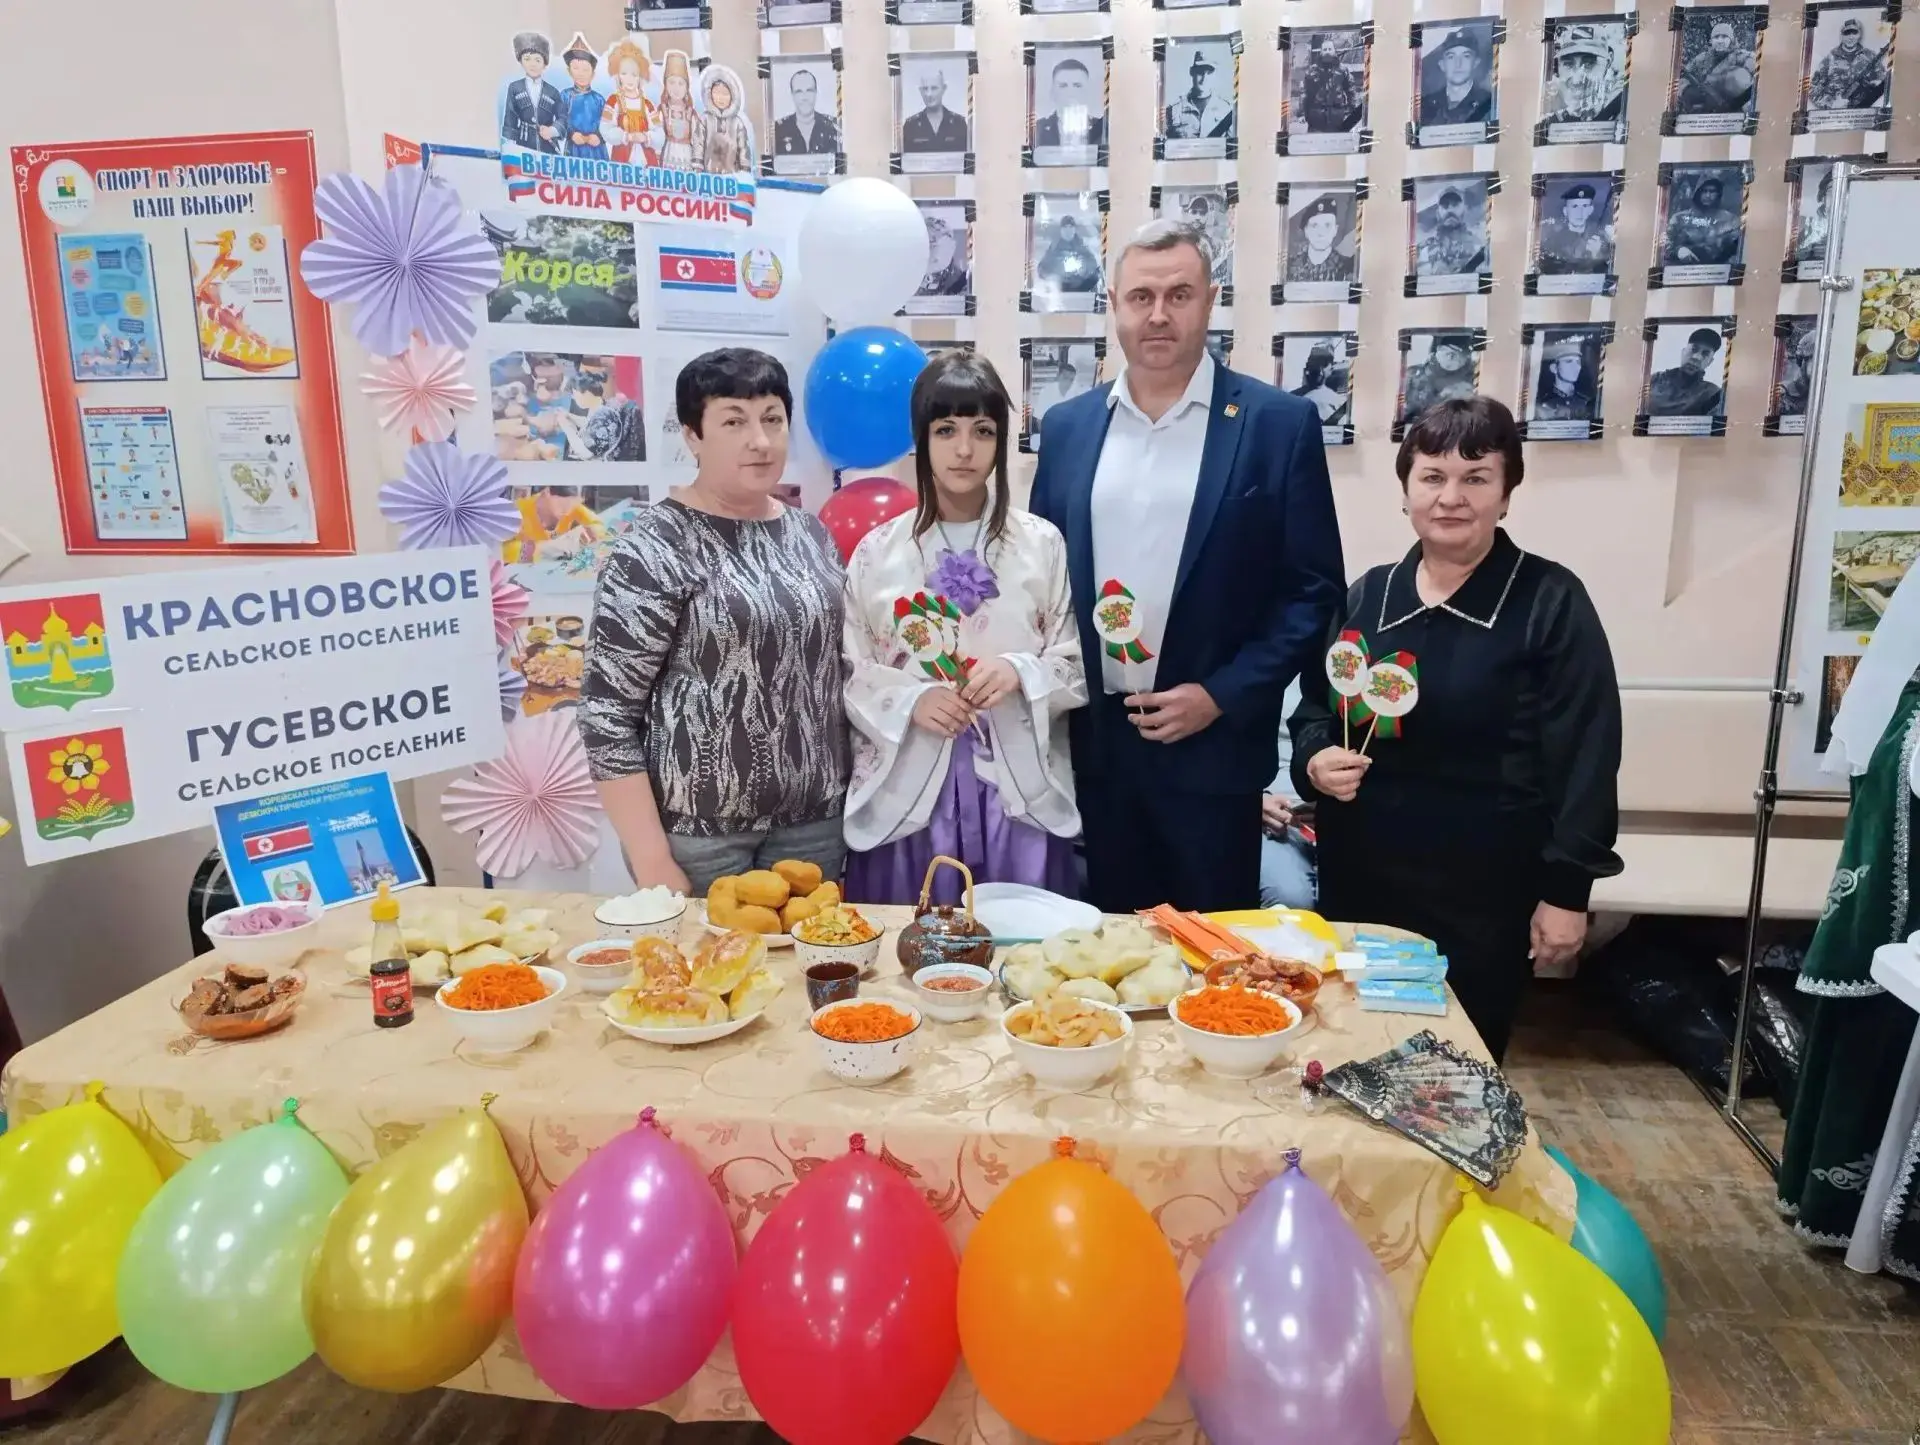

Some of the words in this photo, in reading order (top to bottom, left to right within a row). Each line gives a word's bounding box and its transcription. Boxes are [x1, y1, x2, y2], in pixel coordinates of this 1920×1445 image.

[96, 168, 152, 191] СПОРТ
[157, 171, 169, 189] и
[174, 162, 272, 189] ЗДОРОВЬЕ
[520, 152, 535, 174] В
[540, 154, 648, 187] ЕДИНСТВЕ
[649, 168, 737, 197] НАРОДОВ
[132, 197, 176, 218] НАШ
[180, 192, 255, 217] ВЫБОР!
[538, 182, 612, 210] СИЛА
[620, 190, 728, 222] РОССИИ!
[502, 250, 615, 291] Корея
[122, 569, 479, 641] КРАСНОВСКОЕ
[164, 637, 313, 675] СЕЛЬСКОЕ
[321, 617, 460, 652] ПОСЕЛЕНИЕ
[186, 684, 451, 763] ГУСЕВСКОЕ
[178, 756, 322, 802] СЕЛЬСКОЕ
[331, 726, 466, 770] ПОСЕЛЕНИЕ
[258, 788, 310, 807] КОРЕЙСКАЯ
